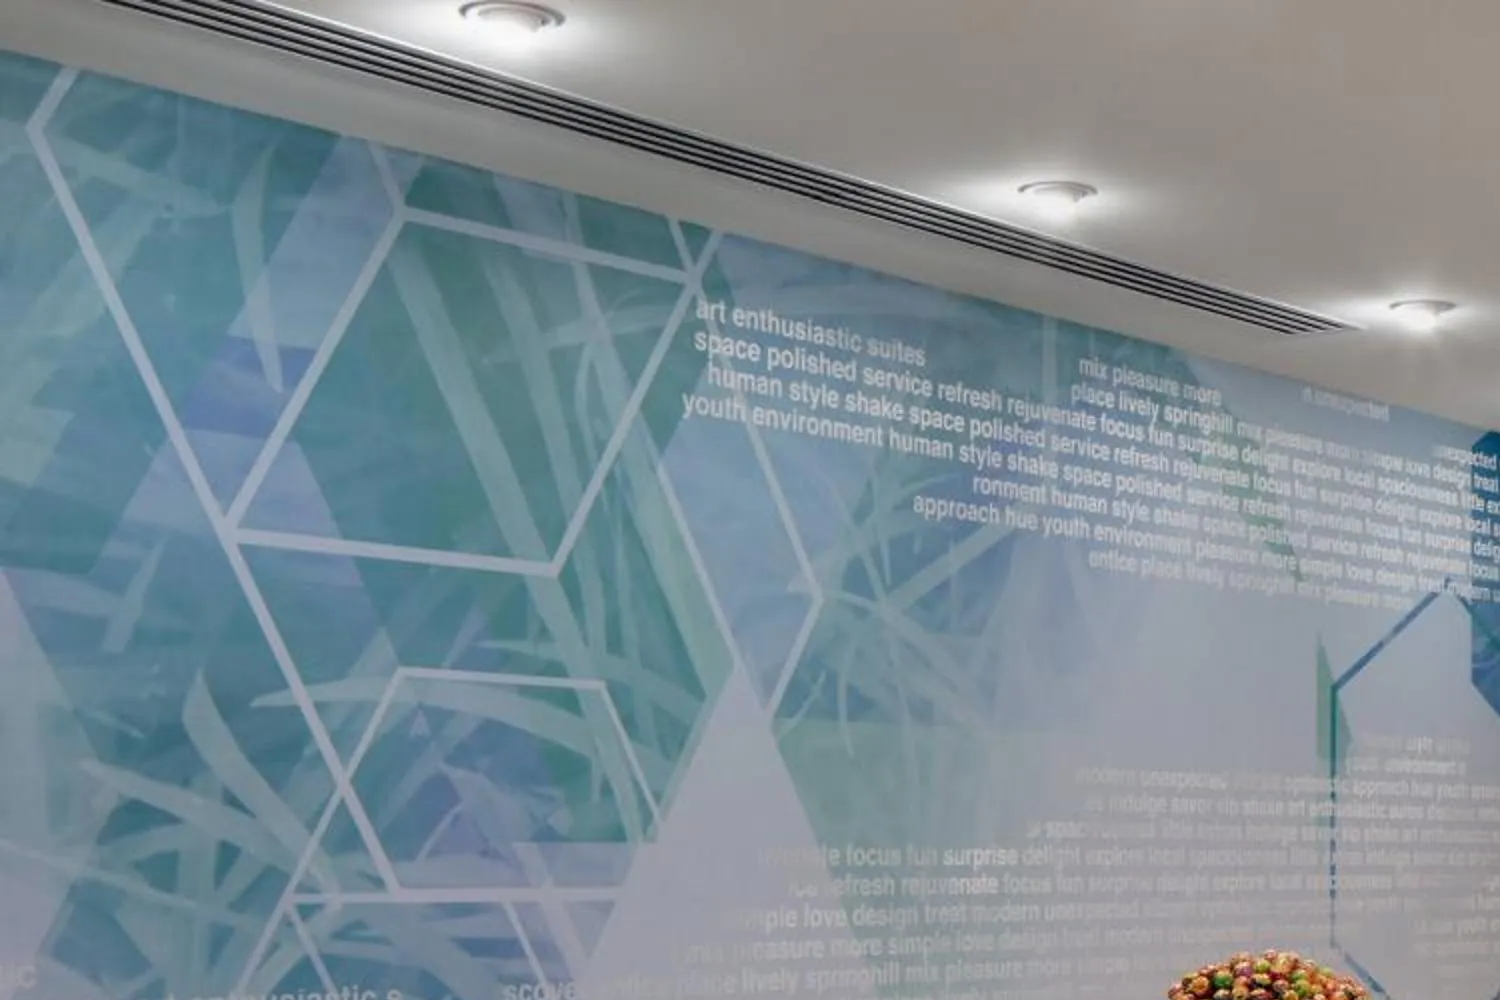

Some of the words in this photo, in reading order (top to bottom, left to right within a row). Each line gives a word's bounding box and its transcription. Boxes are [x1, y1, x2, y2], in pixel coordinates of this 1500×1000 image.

[695, 299, 727, 324] art
[732, 306, 863, 352] enthusiastic
[866, 338, 927, 367] suites
[694, 331, 761, 362] space
[767, 347, 857, 382] polished
[863, 366, 933, 397] service
[938, 381, 1002, 411] refresh
[1007, 397, 1097, 432] rejuvenate
[1101, 413, 1146, 441] focus
[1149, 424, 1175, 448] fun
[1178, 433, 1239, 461] surprise
[1079, 356, 1108, 379] mix
[1112, 365, 1180, 397] pleasure
[708, 363, 782, 398] human
[789, 381, 839, 412] style
[845, 389, 904, 421] shake
[909, 403, 965, 433] space
[970, 416, 1046, 448] polished
[1051, 432, 1110, 461] service
[1114, 446, 1169, 473] refresh
[1174, 458, 1249, 488] rejuvenate
[1071, 384, 1116, 409] place
[1119, 391, 1160, 422] lively
[1164, 407, 1233, 435] springhill
[682, 393, 747, 422] youth
[753, 406, 884, 448] environment
[889, 427, 953, 460] human
[959, 443, 1001, 471] style
[1007, 455, 1059, 480] shake
[1063, 464, 1112, 489] space
[1116, 474, 1182, 500] polished
[913, 495, 999, 524] approach
[1006, 505, 1038, 531] hue
[1043, 513, 1090, 539] youth
[973, 475, 1047, 500] ronment
[1051, 488, 1108, 515] human
[1112, 499, 1149, 525] style
[943, 846, 1019, 871] surprise
